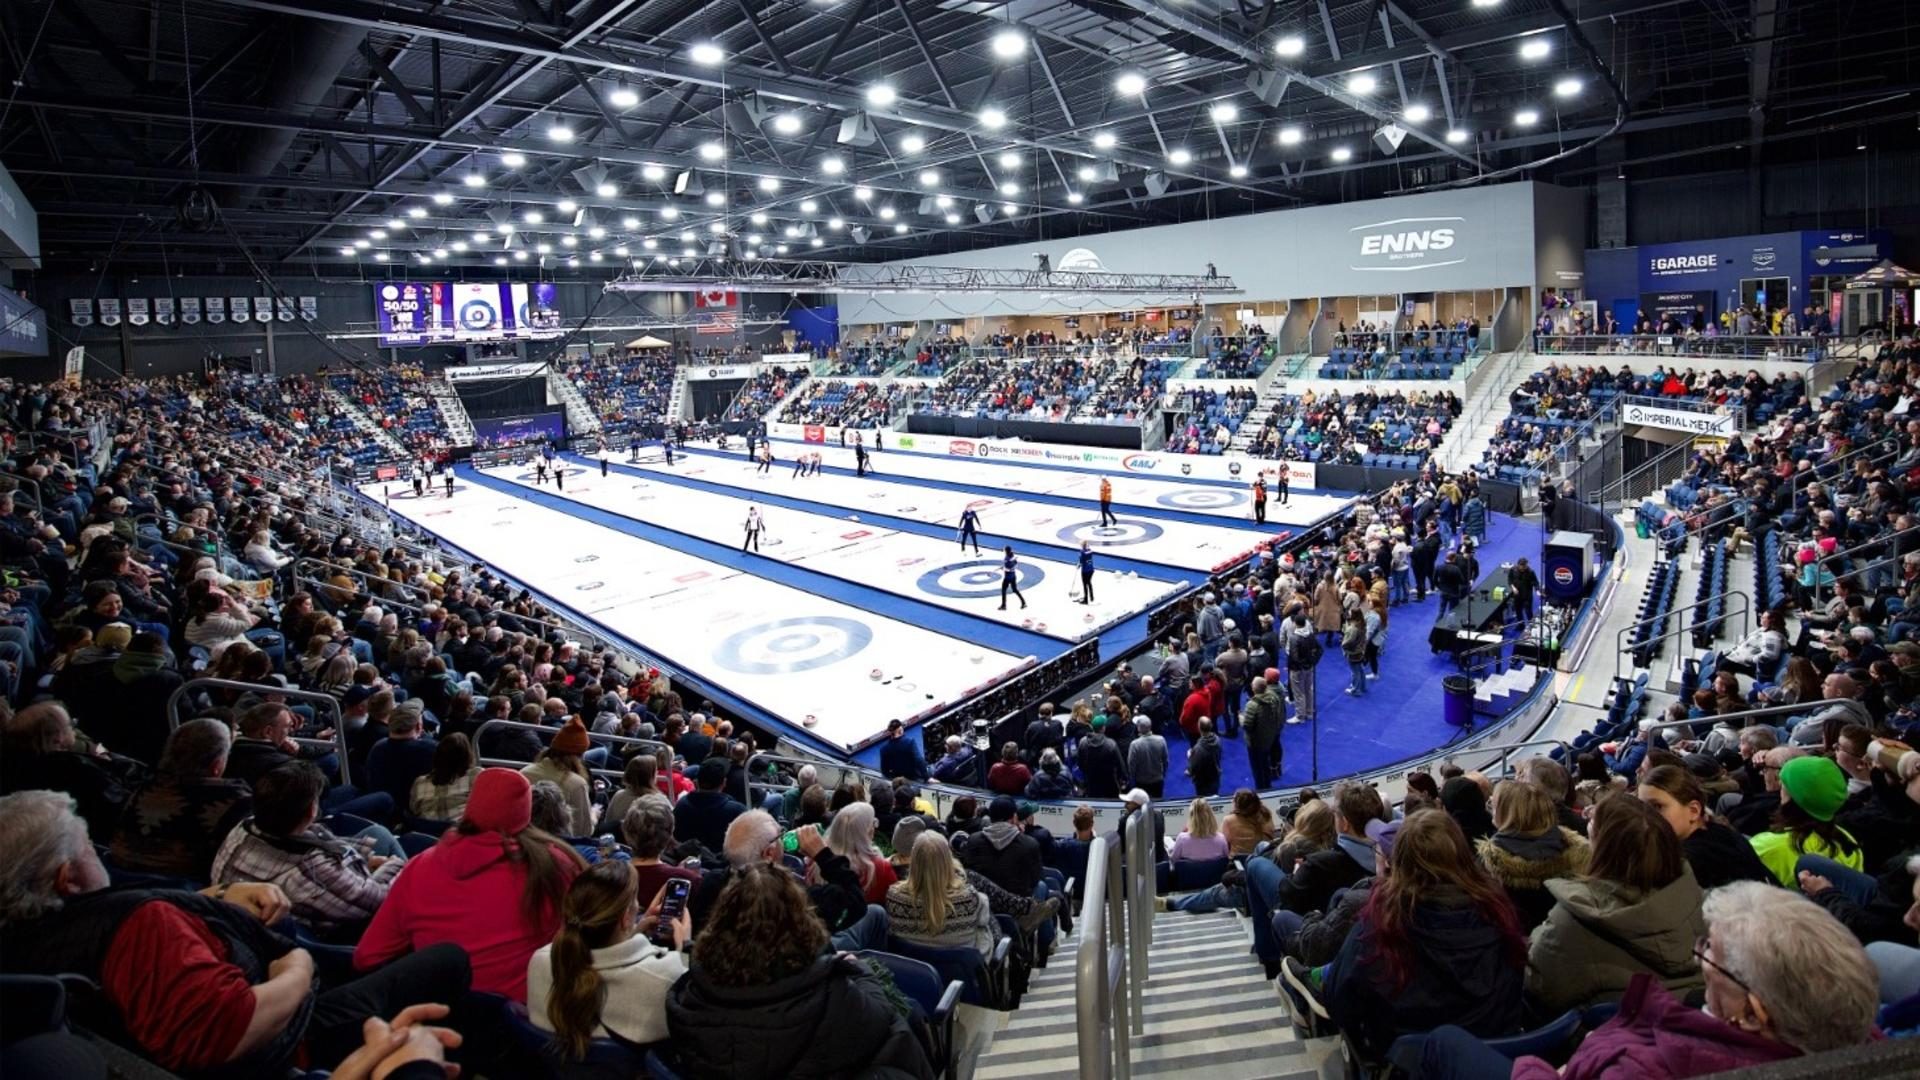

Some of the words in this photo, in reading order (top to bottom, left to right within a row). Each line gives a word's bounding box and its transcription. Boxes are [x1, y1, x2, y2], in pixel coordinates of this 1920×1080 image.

[1361, 229, 1455, 255] ENNS
[1657, 254, 1717, 270] GARAGE
[384, 301, 418, 312] 50/50
[1644, 413, 1687, 428] IMPERIAL
